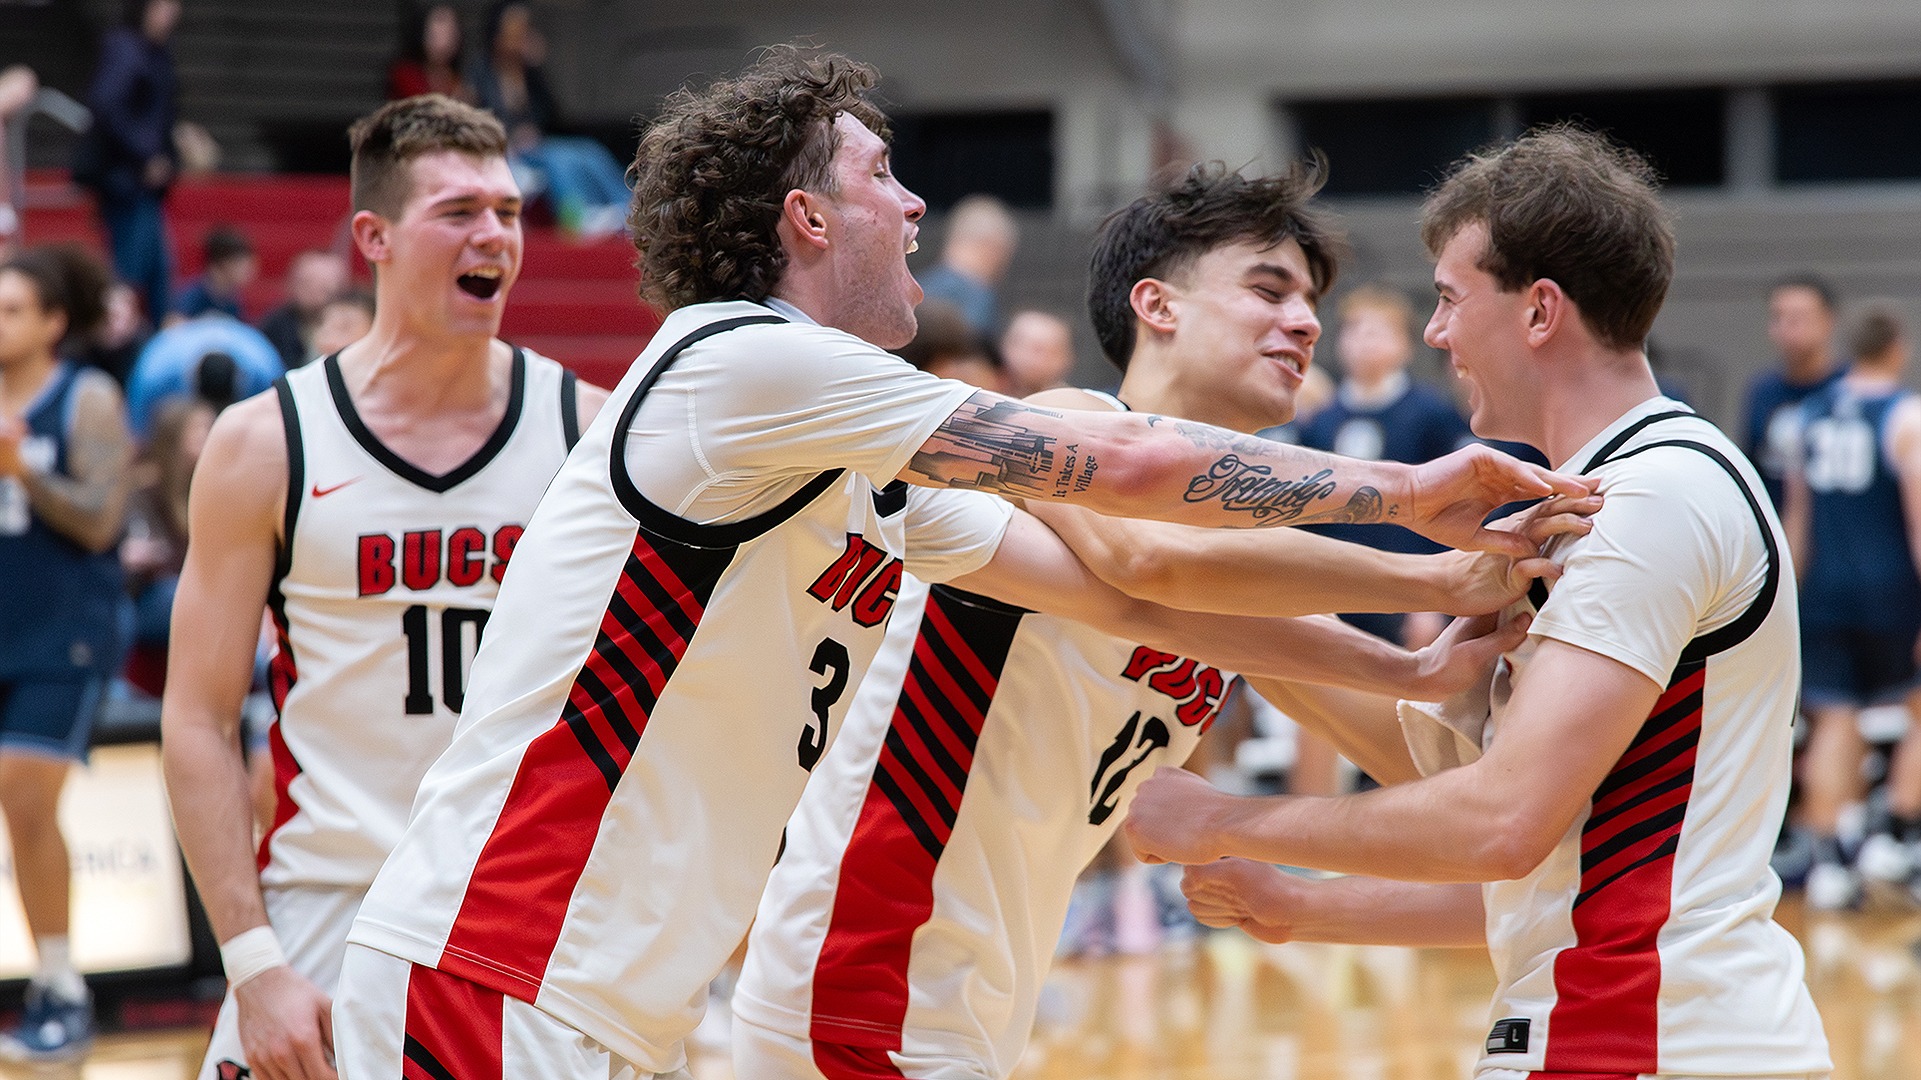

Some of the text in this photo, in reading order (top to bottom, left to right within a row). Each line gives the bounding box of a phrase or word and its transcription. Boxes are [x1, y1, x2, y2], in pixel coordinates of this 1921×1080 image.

[1056, 456, 1076, 487] Takes
[1066, 444, 1078, 453] A
[1073, 455, 1098, 492] Village
[1184, 454, 1336, 526] Family
[806, 532, 903, 632] BUC
[403, 605, 493, 714] 10
[797, 636, 850, 772] 3
[1121, 645, 1239, 735] BUC
[1088, 710, 1170, 826] 12
